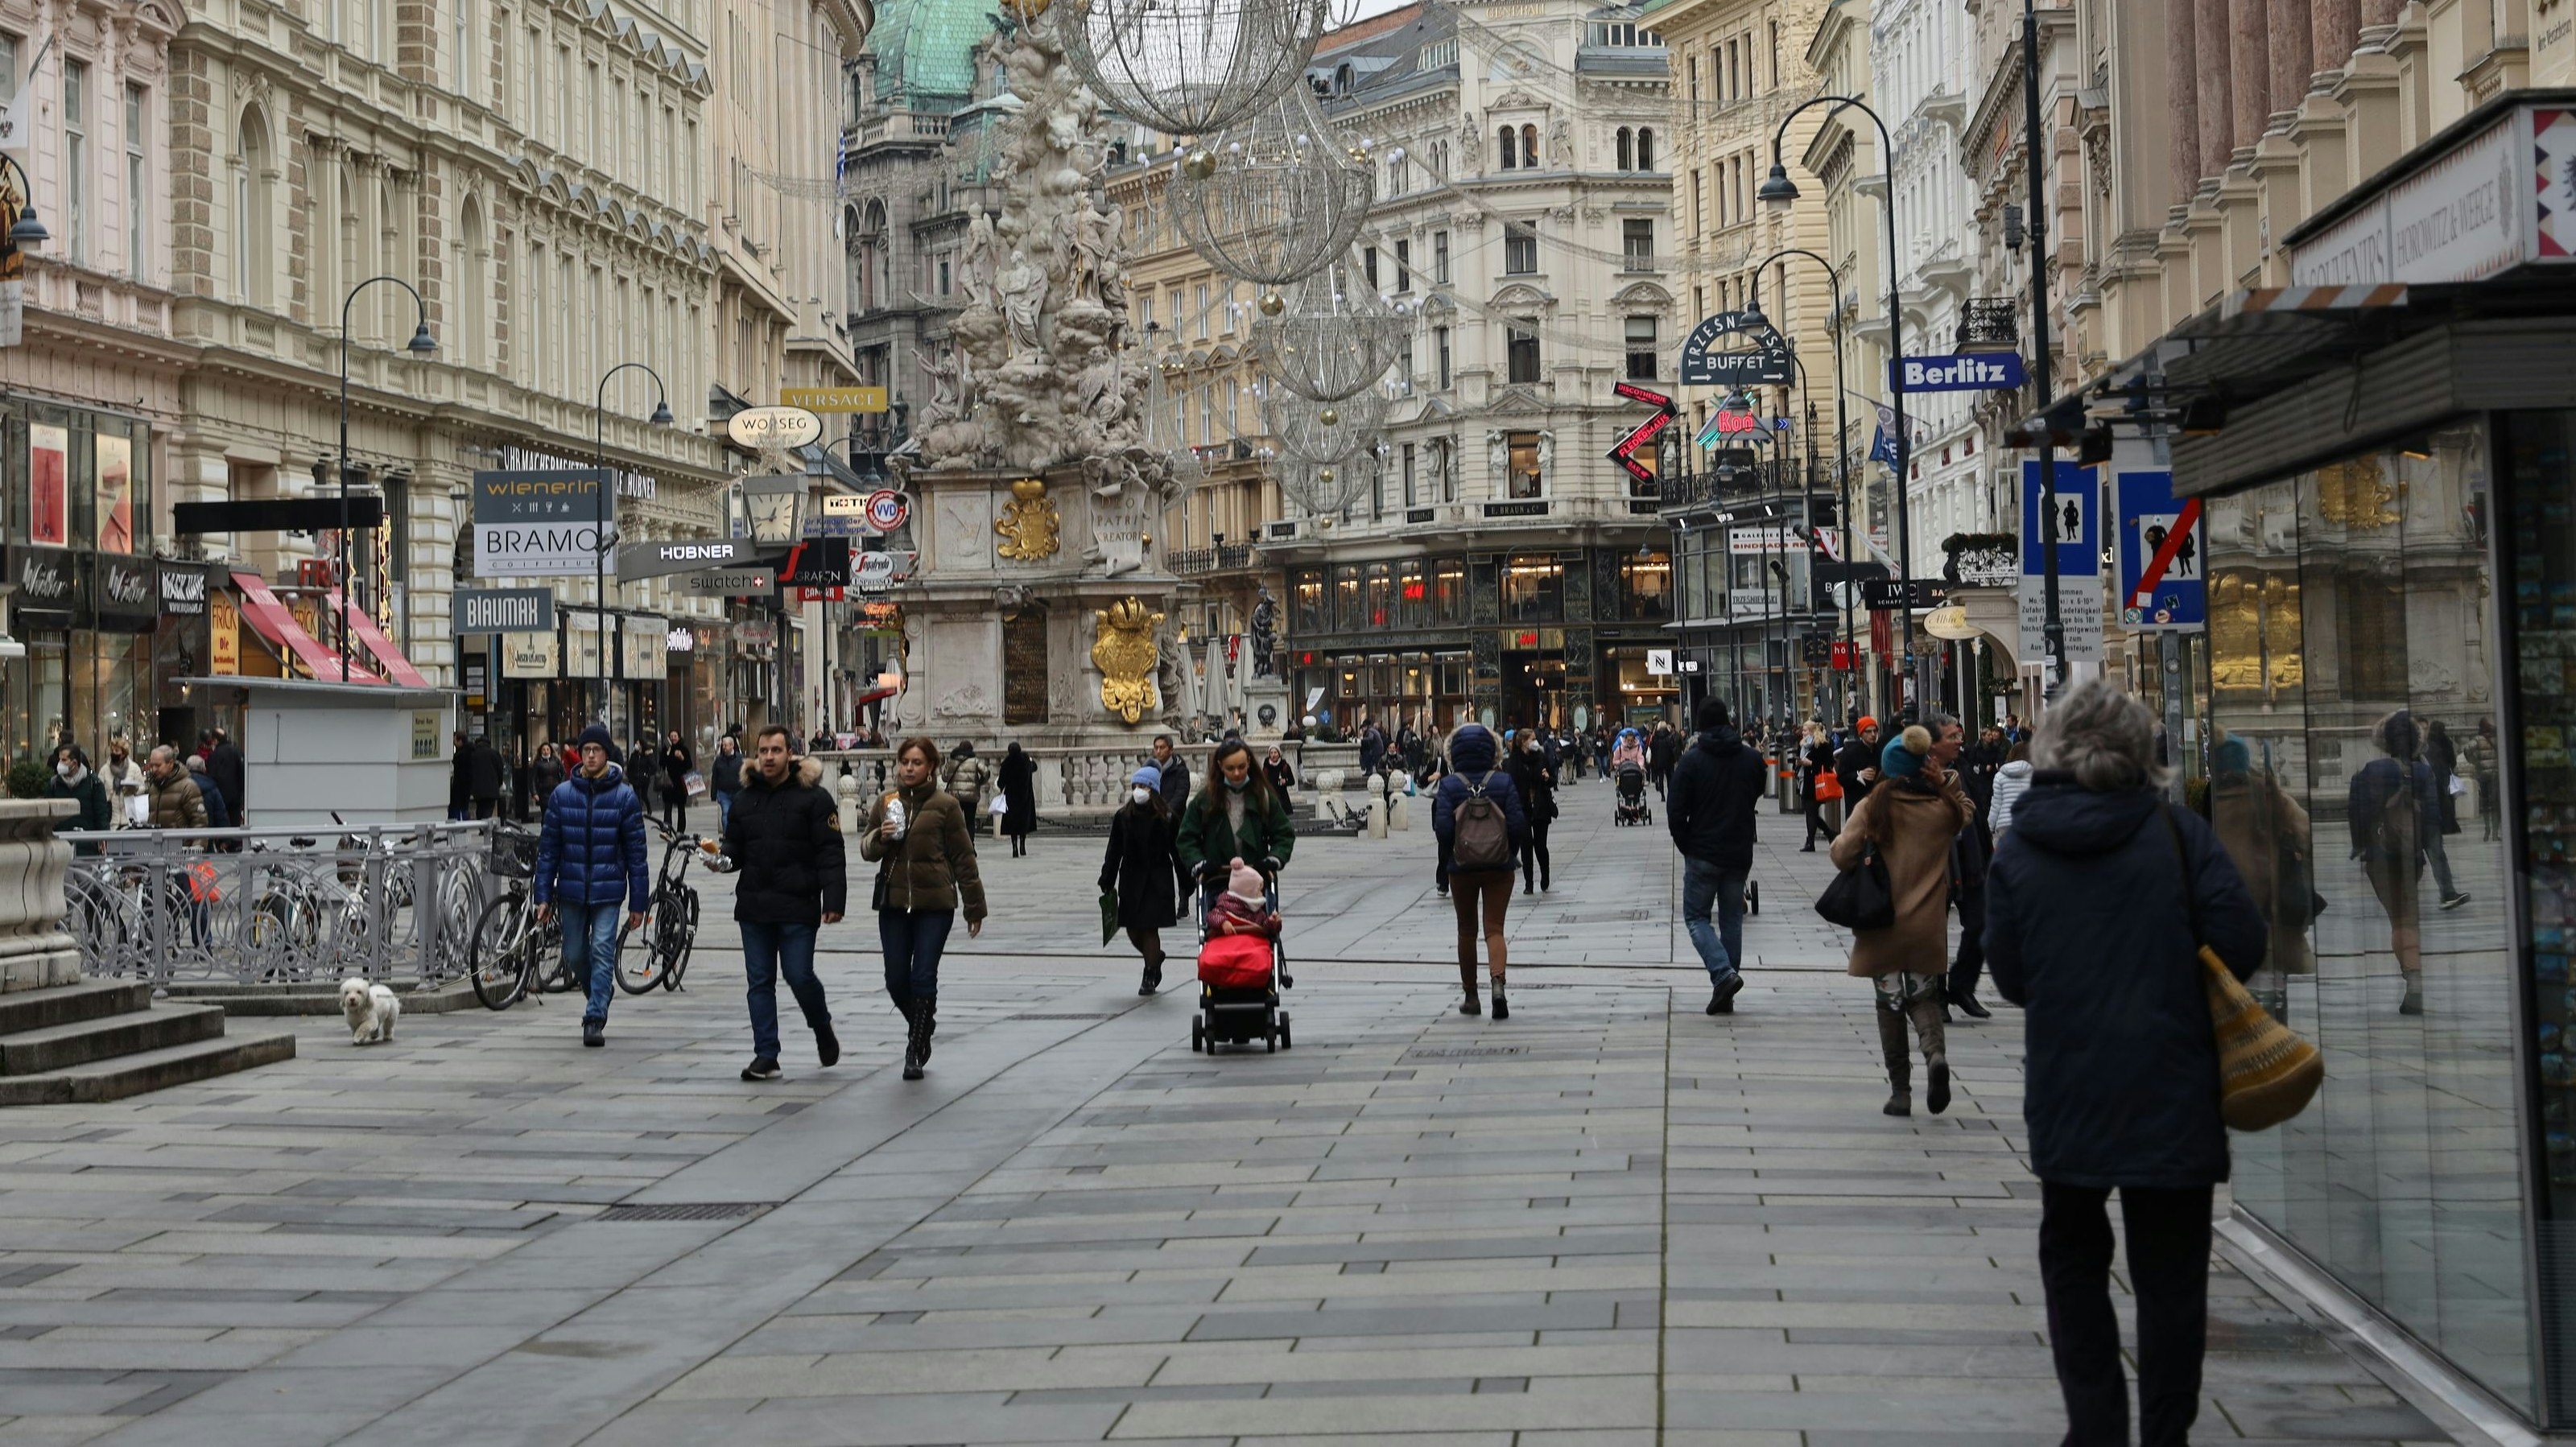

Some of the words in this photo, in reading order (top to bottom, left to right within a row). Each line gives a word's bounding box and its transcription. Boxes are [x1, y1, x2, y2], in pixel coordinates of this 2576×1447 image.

[2396, 206, 2448, 268] HOROWITZ
[2450, 204, 2458, 241] &
[2459, 180, 2495, 232] WEEGE
[1688, 315, 1785, 368] TRZEŚNWSKI
[1707, 356, 1765, 369] BUFFET
[1905, 357, 2005, 385] Berlitz
[792, 393, 875, 407] VERSACE
[1618, 384, 1667, 403] DISCOTHEQUE
[742, 418, 807, 430] WOSEG
[1618, 413, 1670, 458] FLEDERMAUS
[1627, 460, 1642, 473] BAR
[487, 479, 598, 496] wienerin
[628, 468, 656, 501] HÜBNER
[876, 504, 896, 517] VVD
[1500, 506, 1525, 514] BRAUN
[1097, 515, 1138, 526] PATRI
[1097, 531, 1141, 542] CREATORI
[660, 544, 734, 560] HÜBNER
[856, 555, 890, 572] Segafredo
[691, 575, 752, 588] swatch
[853, 576, 891, 586] ESPRESSO
[805, 586, 835, 600] CAMER
[1888, 583, 1917, 597] IWC
[212, 600, 237, 631] FRICK
[2022, 606, 2045, 614] Zufahrt
[2060, 607, 2100, 615] Ladetätigkeit
[294, 606, 317, 634] FRICK
[2040, 616, 2072, 625] Fauge
[220, 636, 229, 650] Die
[1834, 645, 1858, 653] höl
[2065, 644, 2093, 652] insteigen
